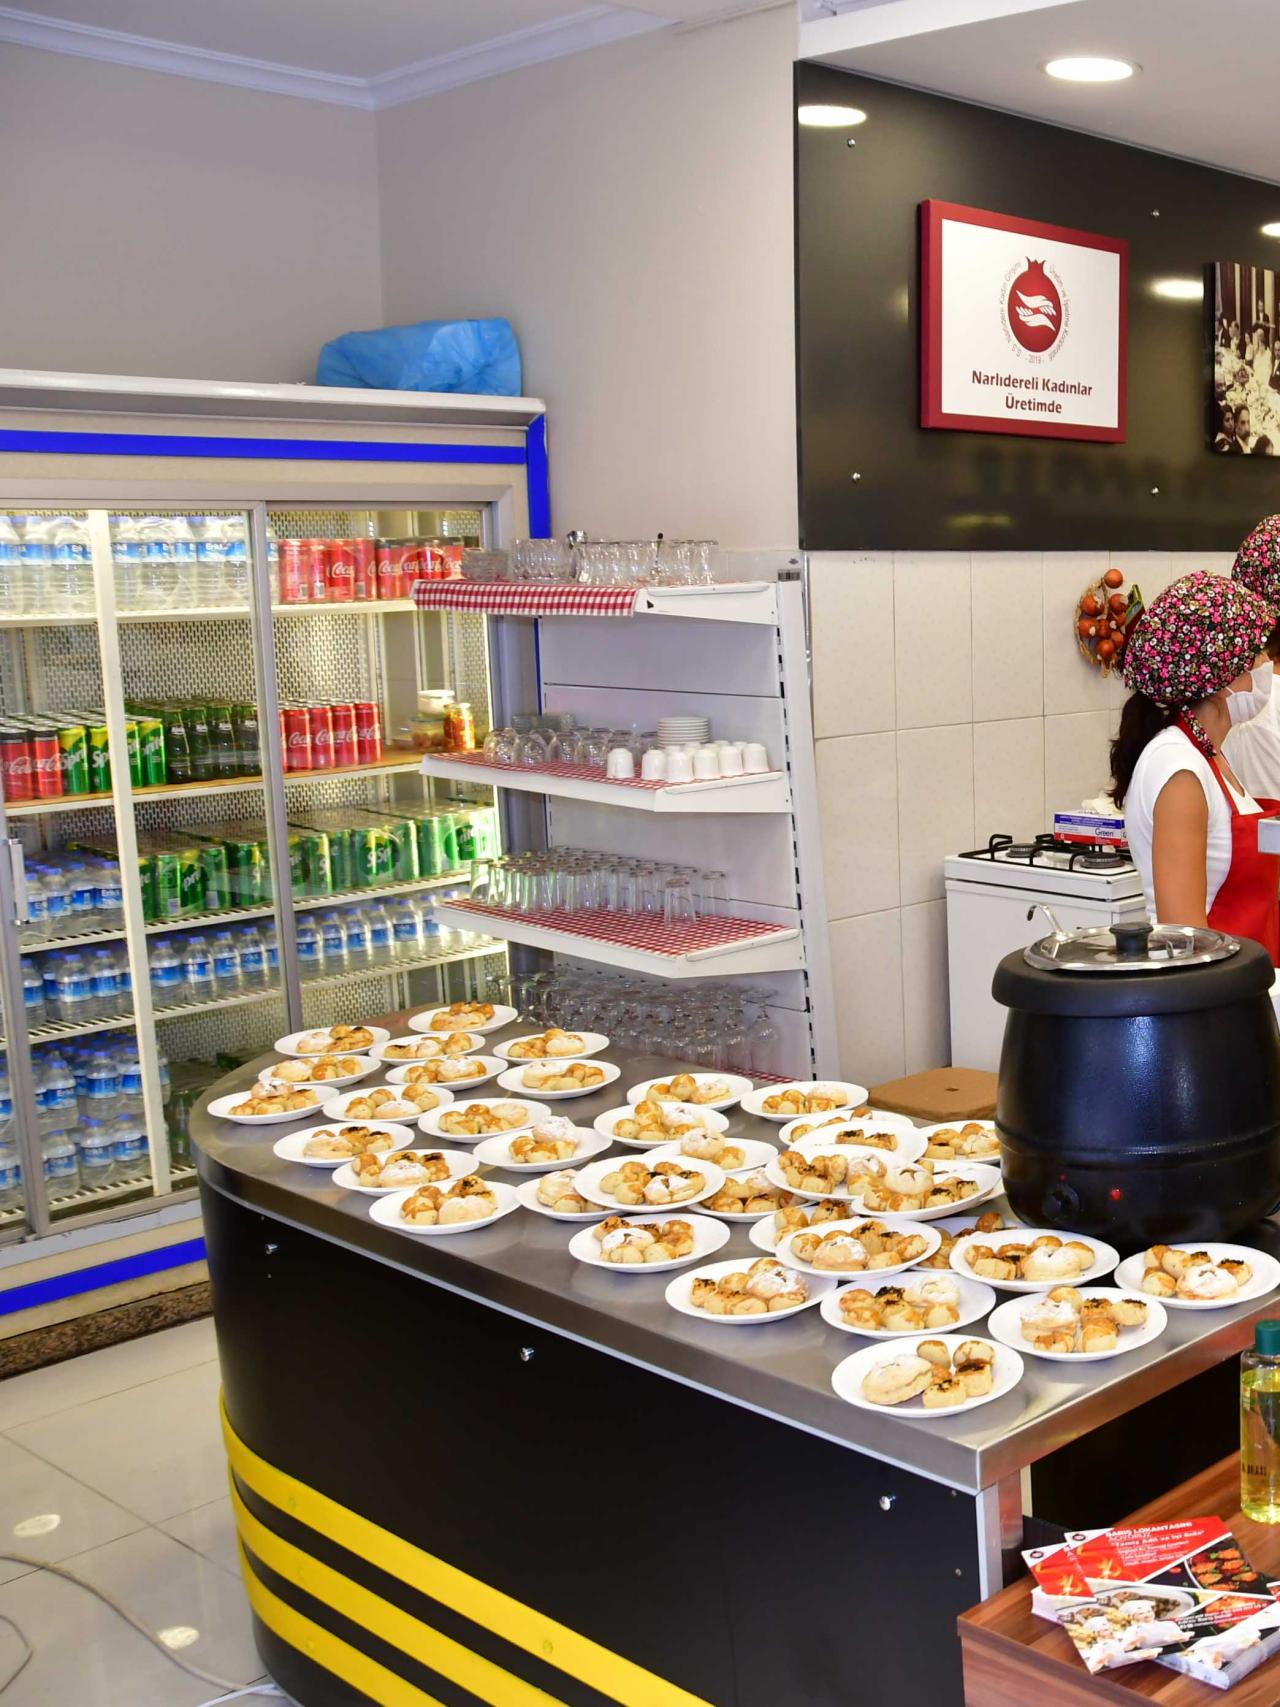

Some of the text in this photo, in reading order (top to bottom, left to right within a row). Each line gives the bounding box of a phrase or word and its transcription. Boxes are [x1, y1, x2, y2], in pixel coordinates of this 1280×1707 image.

[972, 370, 1093, 396] Narlıdereli Kadınlar
[1005, 393, 1063, 414] Üretimde
[1094, 827, 1114, 838] Green
